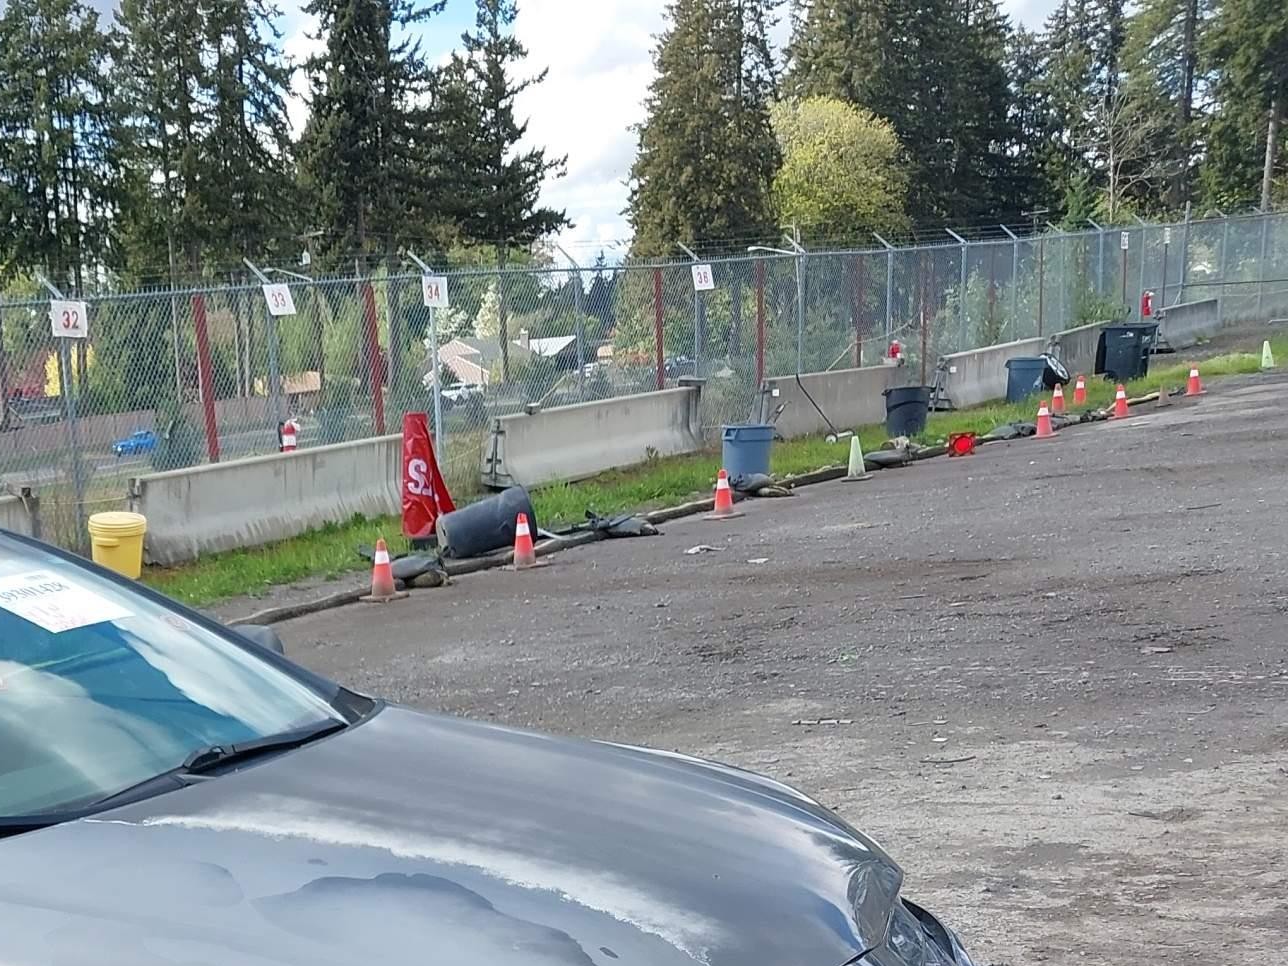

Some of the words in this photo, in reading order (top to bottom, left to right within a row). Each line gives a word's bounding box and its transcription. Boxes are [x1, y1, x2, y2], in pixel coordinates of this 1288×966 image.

[271, 292, 287, 308] 33
[427, 284, 440, 301] 34
[62, 310, 80, 329] 32
